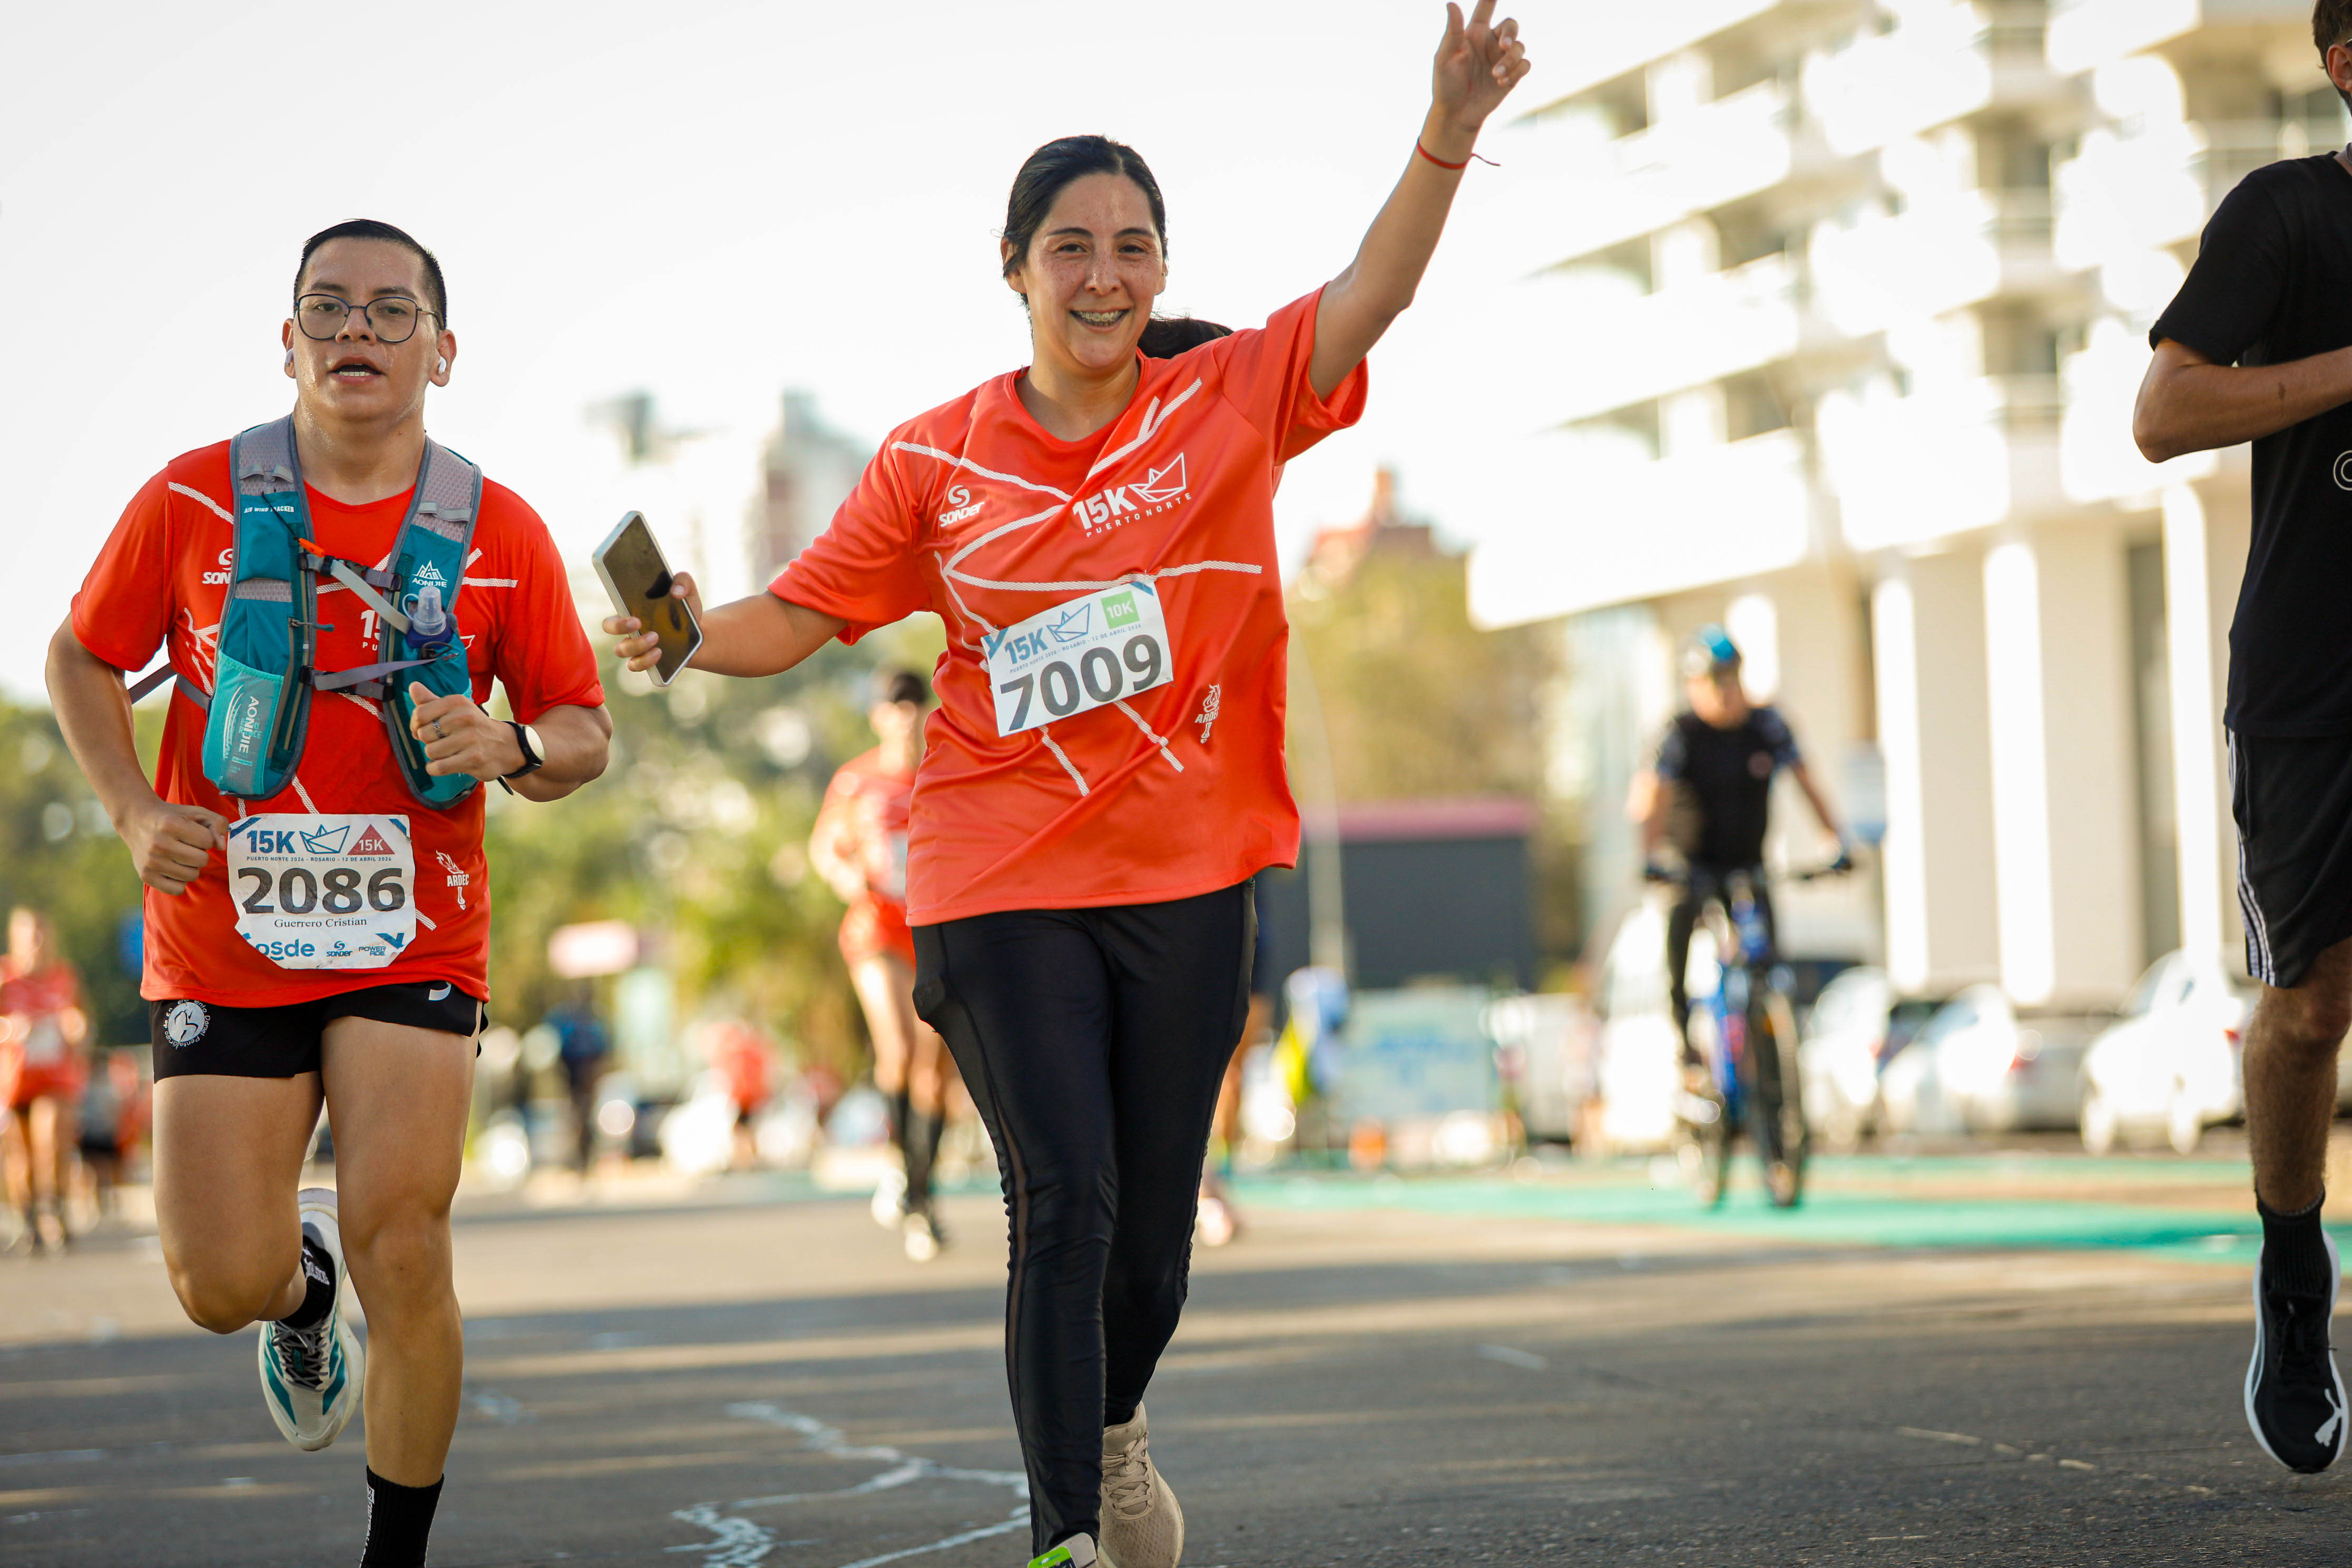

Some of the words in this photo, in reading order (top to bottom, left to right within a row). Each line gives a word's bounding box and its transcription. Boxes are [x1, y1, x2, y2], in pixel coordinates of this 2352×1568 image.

[1072, 486, 1138, 530] 15K
[1086, 513, 1140, 537] PUERTO
[1146, 493, 1192, 516] NORTE
[202, 572, 231, 585] SON
[412, 577, 447, 588] AONIJIE
[1107, 601, 1134, 619] 10K
[1004, 628, 1048, 664] 15K
[1010, 663, 1028, 674] PUERTO
[1030, 656, 1044, 667] NORTE
[1062, 639, 1086, 651] ROSARIO
[1000, 634, 1162, 731] 7009
[238, 695, 260, 753] AONIJIE
[247, 830, 296, 853] 15K
[359, 839, 384, 851] 15K
[238, 867, 406, 915] 2086
[447, 874, 469, 887] ARDEC
[275, 919, 322, 927] Guerrero
[256, 938, 315, 957] osde
[200, 1015, 211, 1036] Daniel
[180, 1036, 200, 1047] Penta
